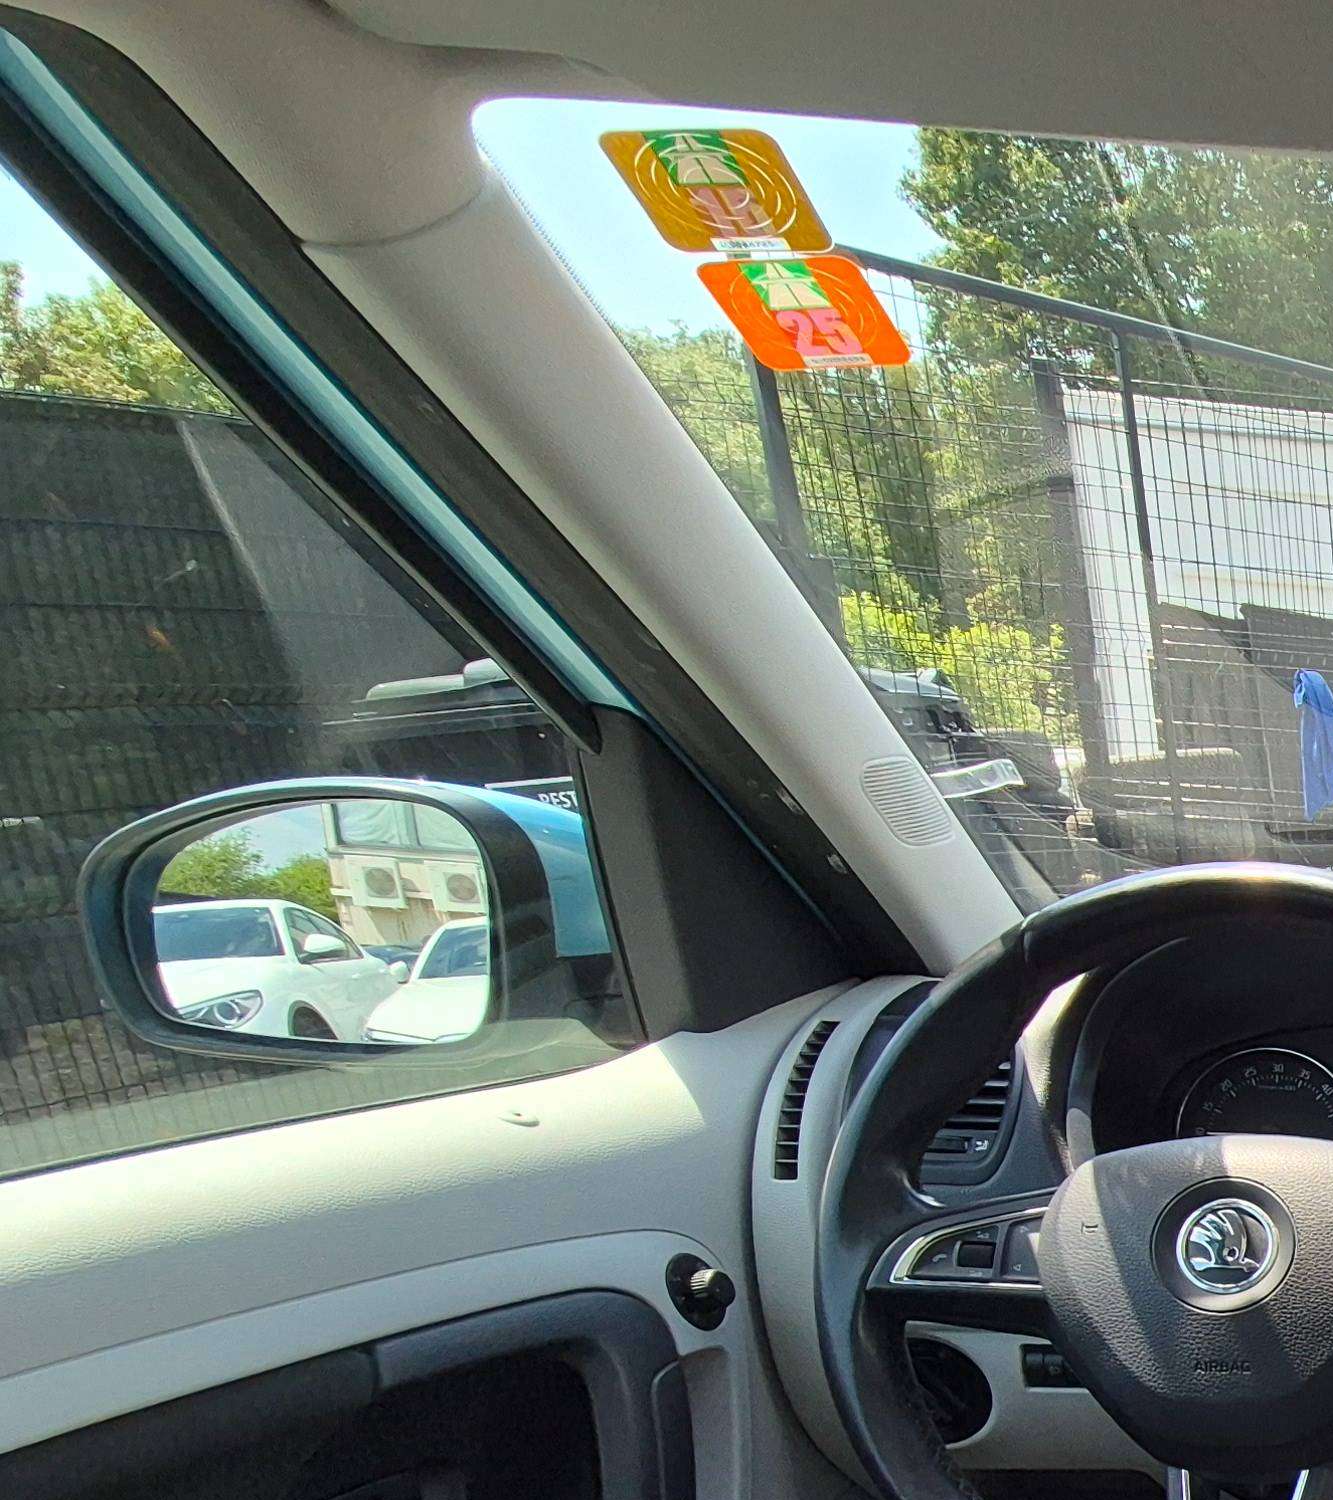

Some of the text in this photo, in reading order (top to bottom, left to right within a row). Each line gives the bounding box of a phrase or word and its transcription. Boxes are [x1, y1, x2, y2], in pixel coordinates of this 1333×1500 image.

[775, 309, 864, 357] 25
[1273, 1064, 1284, 1073] 30
[1298, 1068, 1311, 1079] 35
[1321, 1084, 1333, 1095] 40
